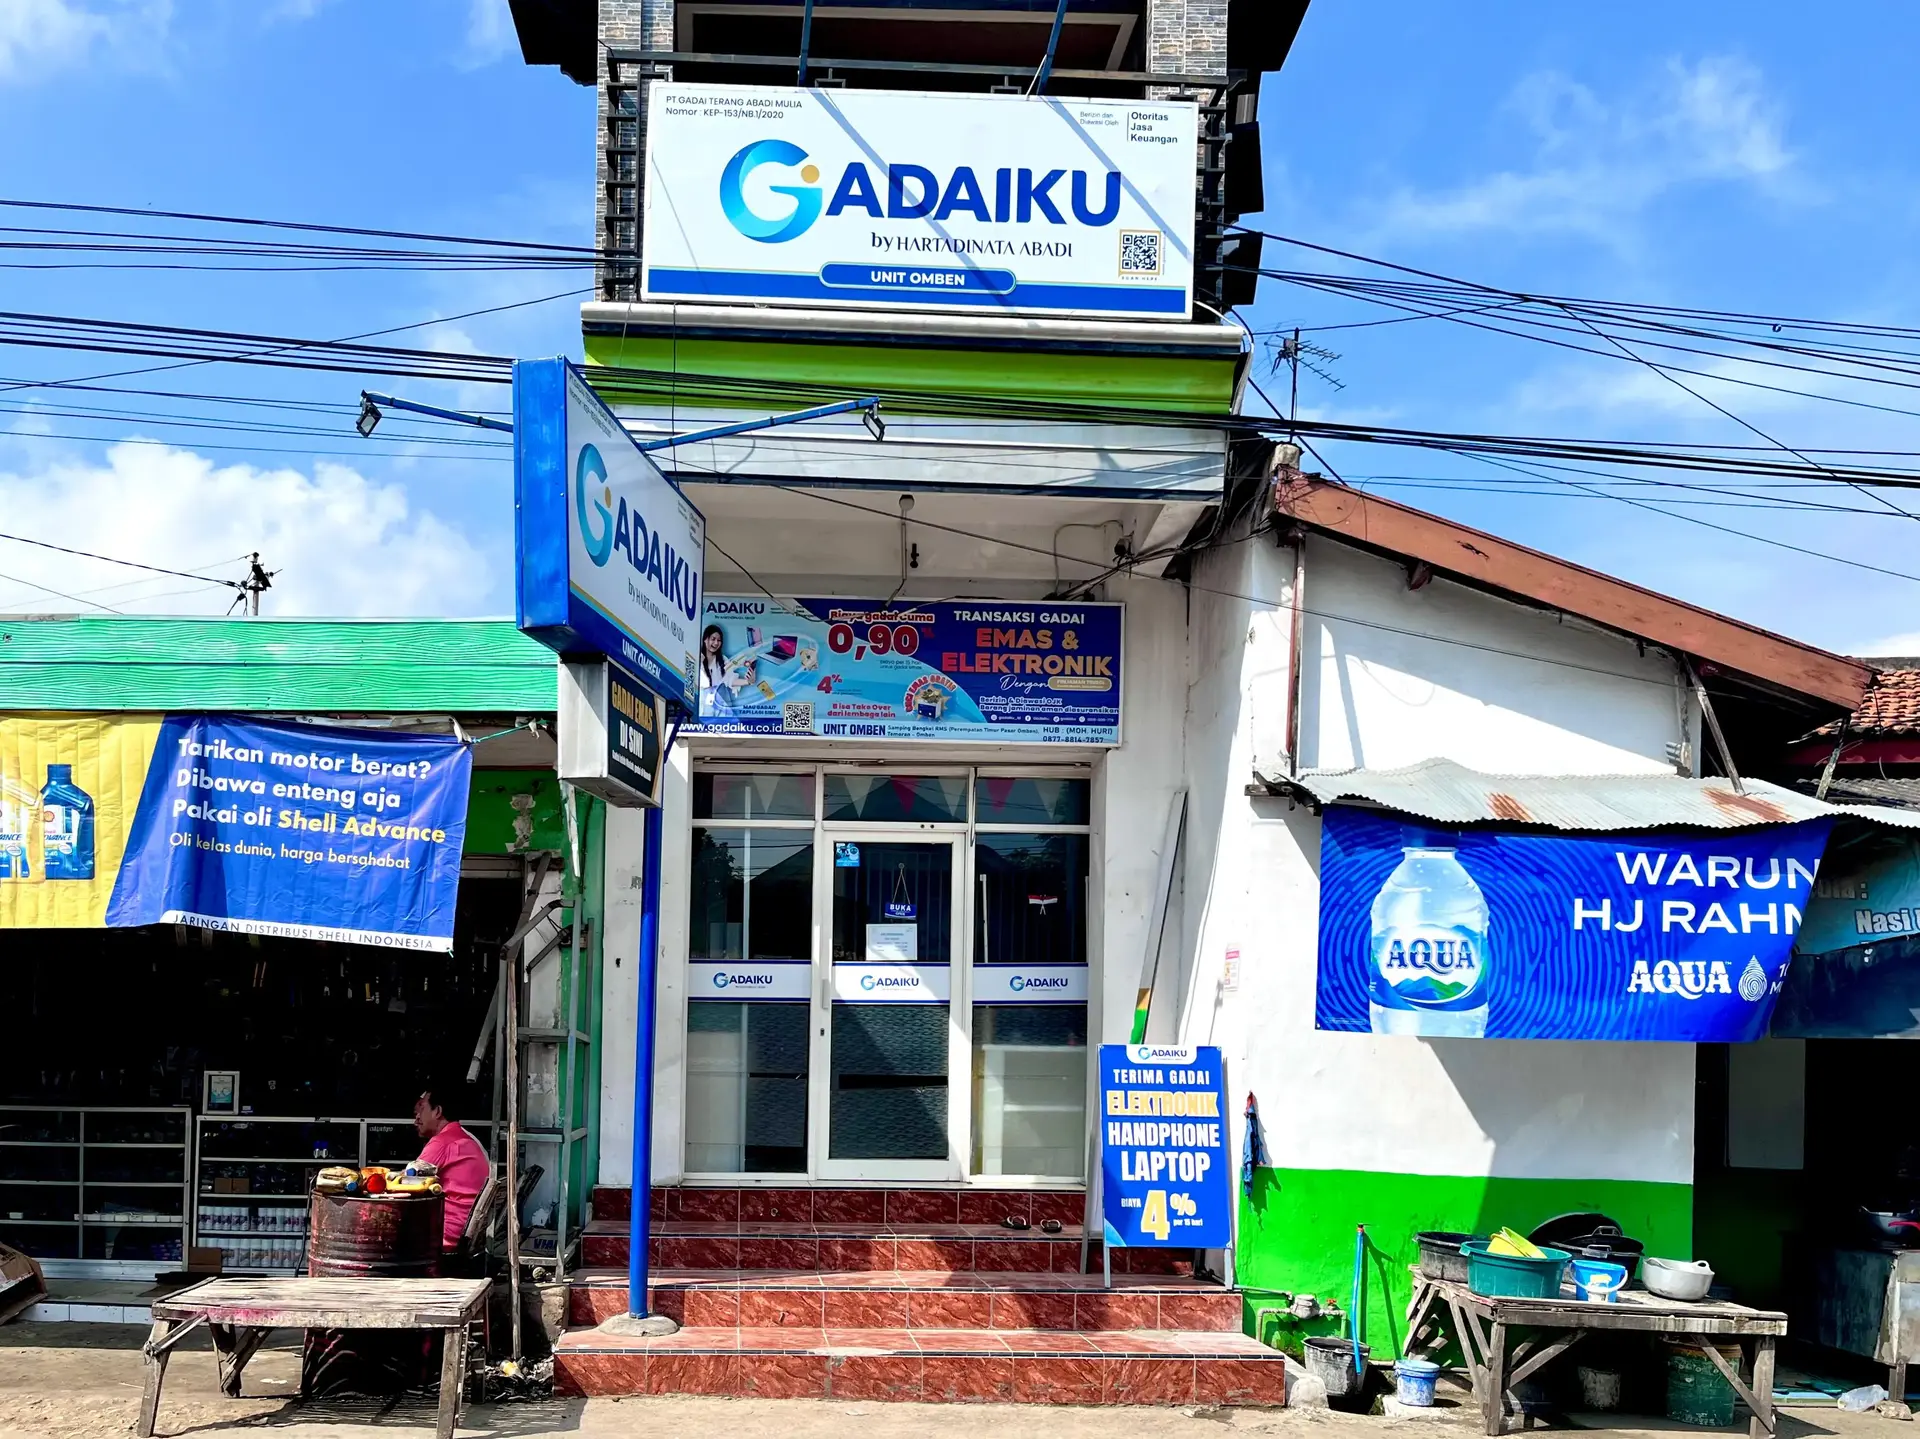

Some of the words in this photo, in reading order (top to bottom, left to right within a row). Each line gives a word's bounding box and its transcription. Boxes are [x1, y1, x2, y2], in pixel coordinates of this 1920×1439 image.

[666, 107, 697, 116] Nomor
[703, 108, 784, 119] KEP-153/NB.1/2020
[709, 97, 744, 106] TERANG
[746, 98, 774, 107] ABADI
[775, 99, 803, 108] MULIA
[1131, 112, 1168, 121] Otoritas
[1131, 123, 1153, 131] Jasa
[1131, 134, 1178, 145] Keuangan
[871, 232, 892, 252] by
[896, 236, 1015, 256] HARTADINATA
[1019, 243, 1073, 258] ABADI
[871, 271, 907, 284] UNIT
[909, 272, 965, 286] OMBEN
[628, 577, 636, 603] by
[636, 587, 670, 631] HARTADINATA
[670, 621, 685, 645] ABADI
[899, 613, 935, 623] cuma
[954, 610, 1035, 623] TRANSAKSI
[1040, 613, 1085, 625] GADAI
[976, 628, 1053, 649] EMAS
[1062, 631, 1079, 650] &
[622, 639, 639, 662] UNIT
[638, 652, 662, 679] OMBEN
[942, 652, 1113, 676] ELEKTRONIK
[1000, 674, 1049, 694] Dengan
[612, 681, 634, 720] GADAI
[634, 697, 653, 733] EMAS
[980, 696, 1007, 704] Berizin
[1015, 696, 1045, 705] Diawasi
[980, 704, 1007, 713] Barang
[1008, 704, 1040, 713] jaminan
[845, 710, 879, 719] lembaga
[620, 720, 628, 750] DI
[629, 726, 643, 759] SINI
[824, 724, 847, 735] UNIT
[850, 724, 886, 735] OMBEN
[178, 739, 263, 763] Tarikan
[270, 752, 345, 772] motor
[352, 753, 431, 779] berat?
[176, 768, 265, 794] Dibawa
[272, 782, 356, 809] enteng
[362, 787, 401, 812] aja
[173, 799, 237, 824] Pakai
[243, 806, 273, 827] oli
[278, 810, 337, 834] Shell
[342, 817, 446, 844] Advance
[169, 832, 192, 846] Oli
[196, 835, 231, 853] kelas
[234, 840, 276, 859] dunia,
[280, 843, 324, 864] harga
[328, 848, 410, 869] bersahabat
[1574, 898, 1644, 932] HJ
[1856, 910, 1910, 933] Nasi
[175, 914, 240, 932] JARINGAN
[245, 924, 313, 939] DISTRIBUSI
[318, 930, 353, 942] SHELL
[359, 932, 433, 949] INDONESIA
[1387, 938, 1475, 975] AQUA
[713, 972, 772, 988] GADAIKU
[861, 975, 919, 990] GADAIKU
[1010, 976, 1068, 991] GADAIKU
[1113, 1069, 1163, 1085] TERIMA
[1169, 1070, 1210, 1085] GADAI
[1106, 1090, 1220, 1117] ELEKTRONIK
[1108, 1122, 1220, 1147] HANDPHONE
[1121, 1151, 1211, 1182] LAPTOP
[1121, 1198, 1142, 1208] BIAYA
